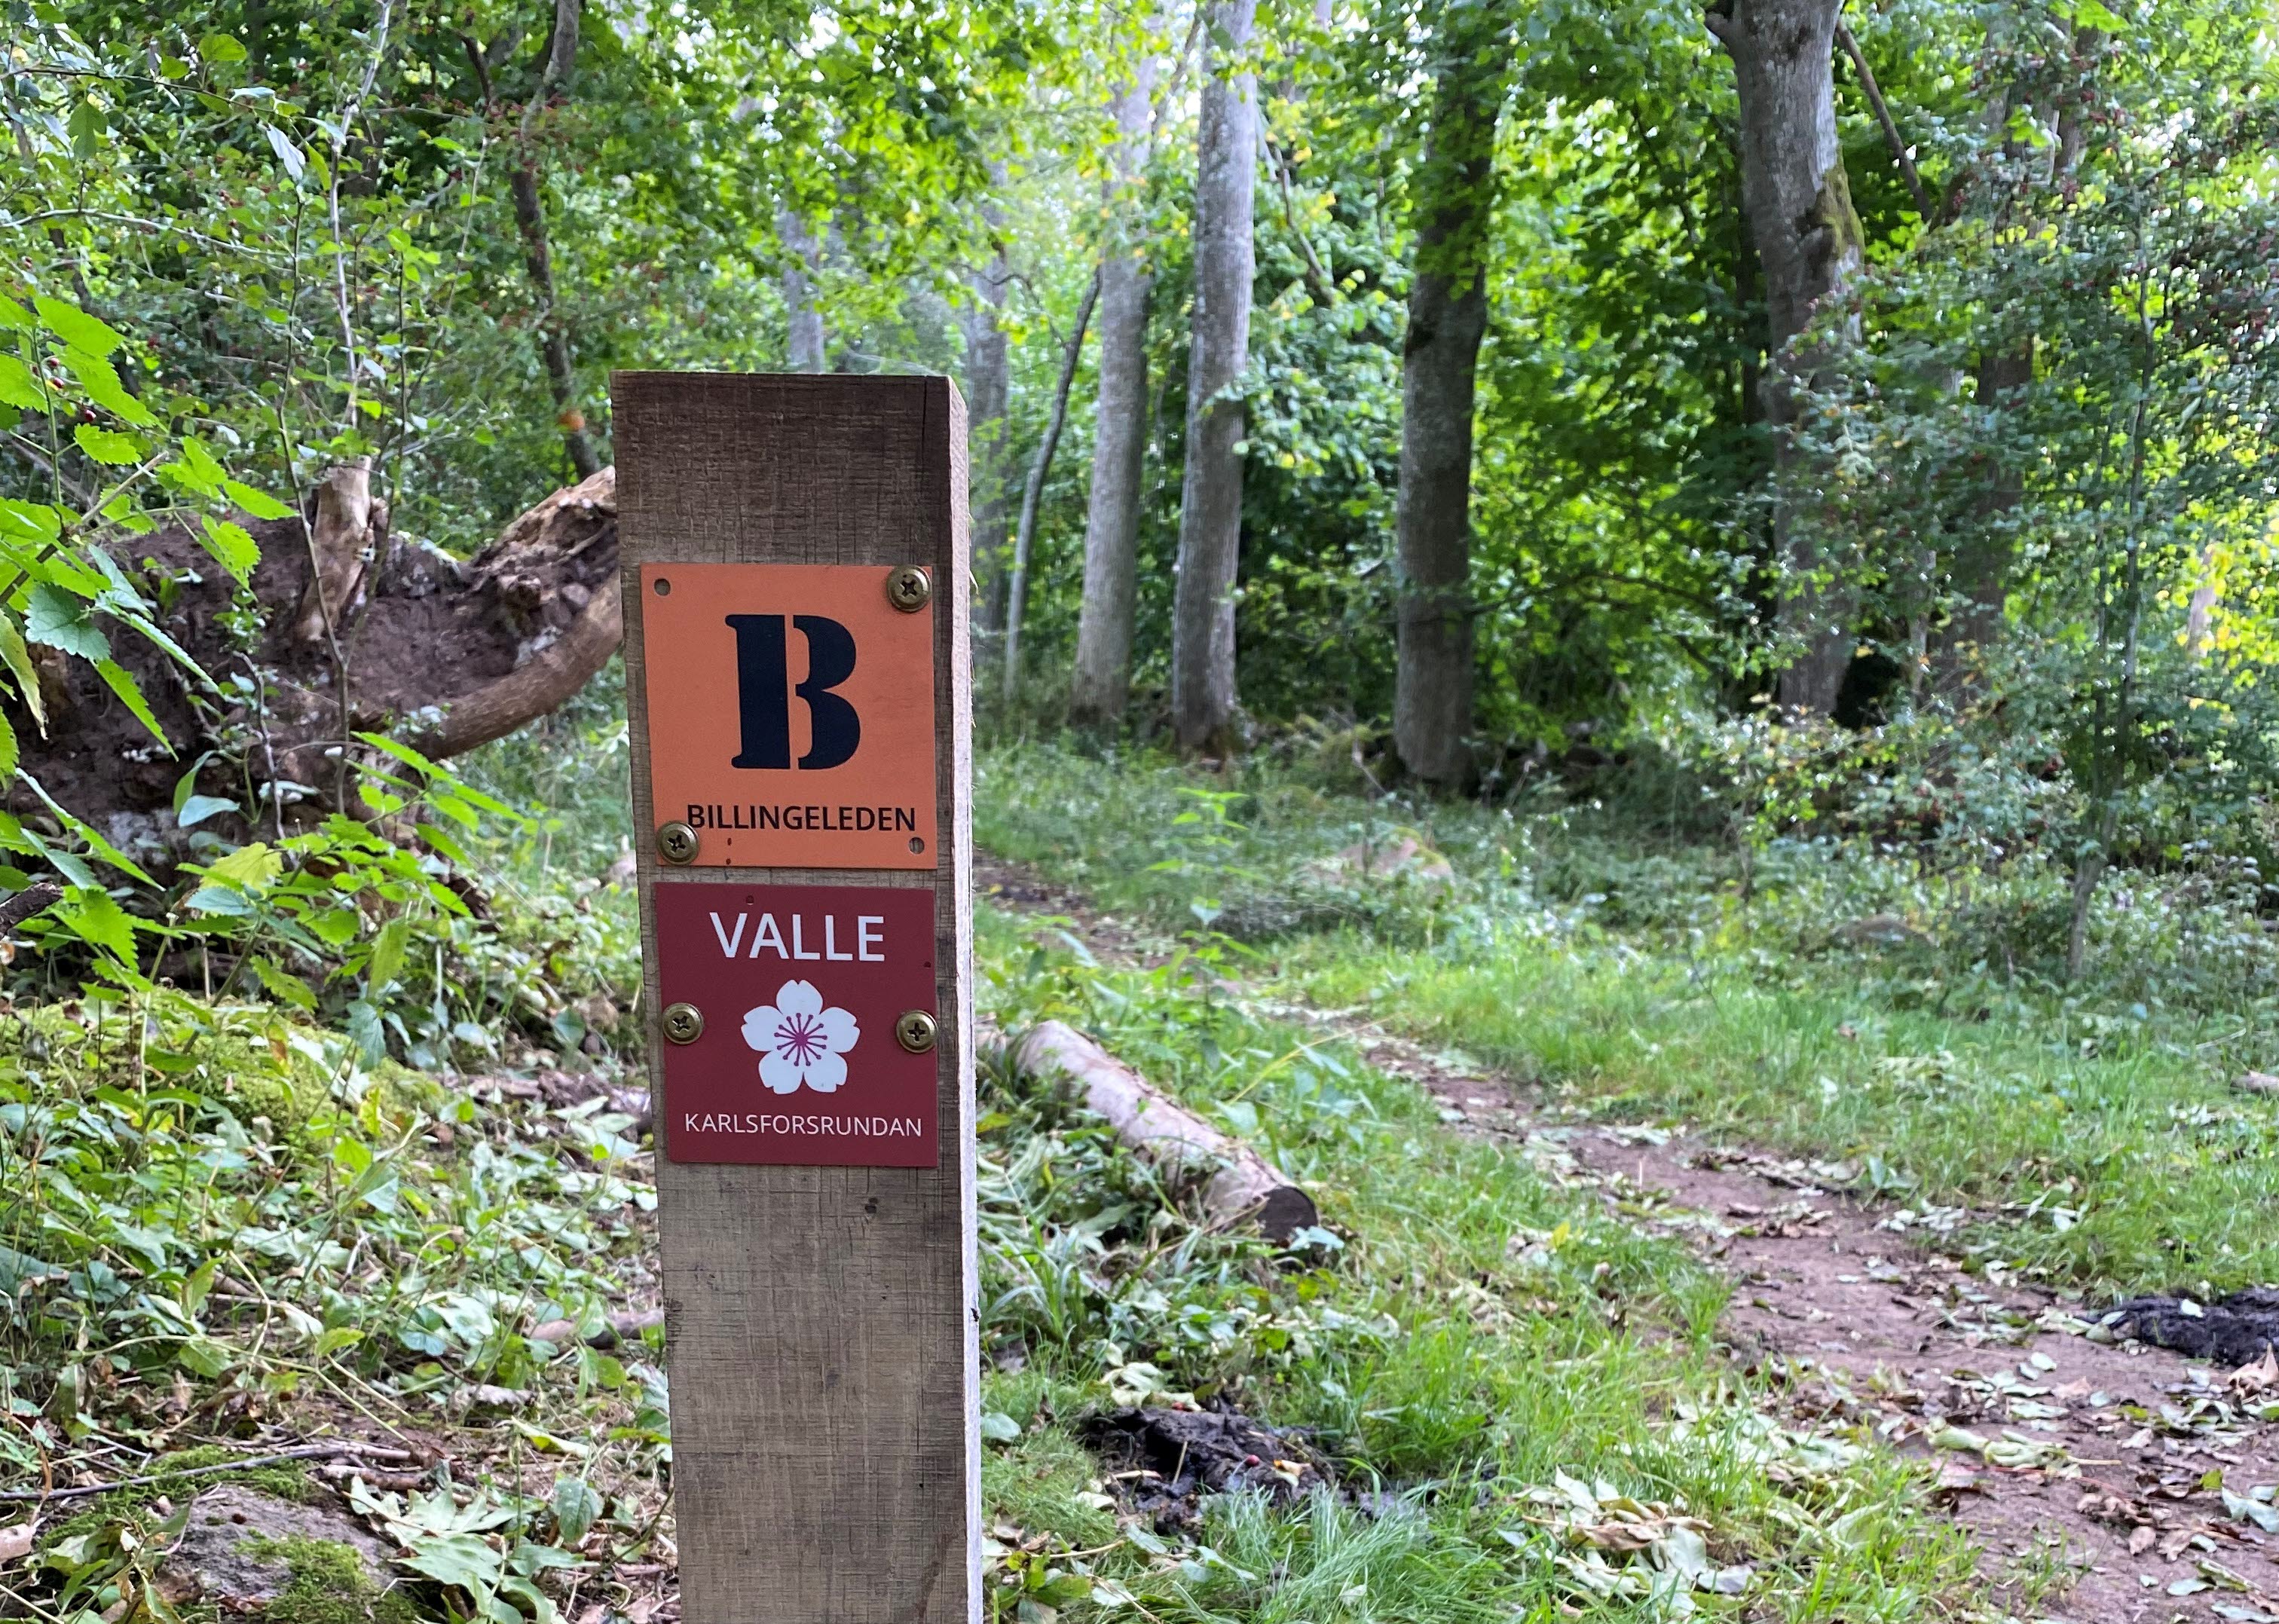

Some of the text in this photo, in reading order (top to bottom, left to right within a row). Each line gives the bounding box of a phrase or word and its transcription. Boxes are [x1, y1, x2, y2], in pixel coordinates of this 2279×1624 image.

[725, 614, 861, 769] B
[687, 804, 916, 832] BILLINGELEDEN
[709, 912, 885, 962] VALLE
[684, 1113, 922, 1136] KARLSFORSRUNDAN
